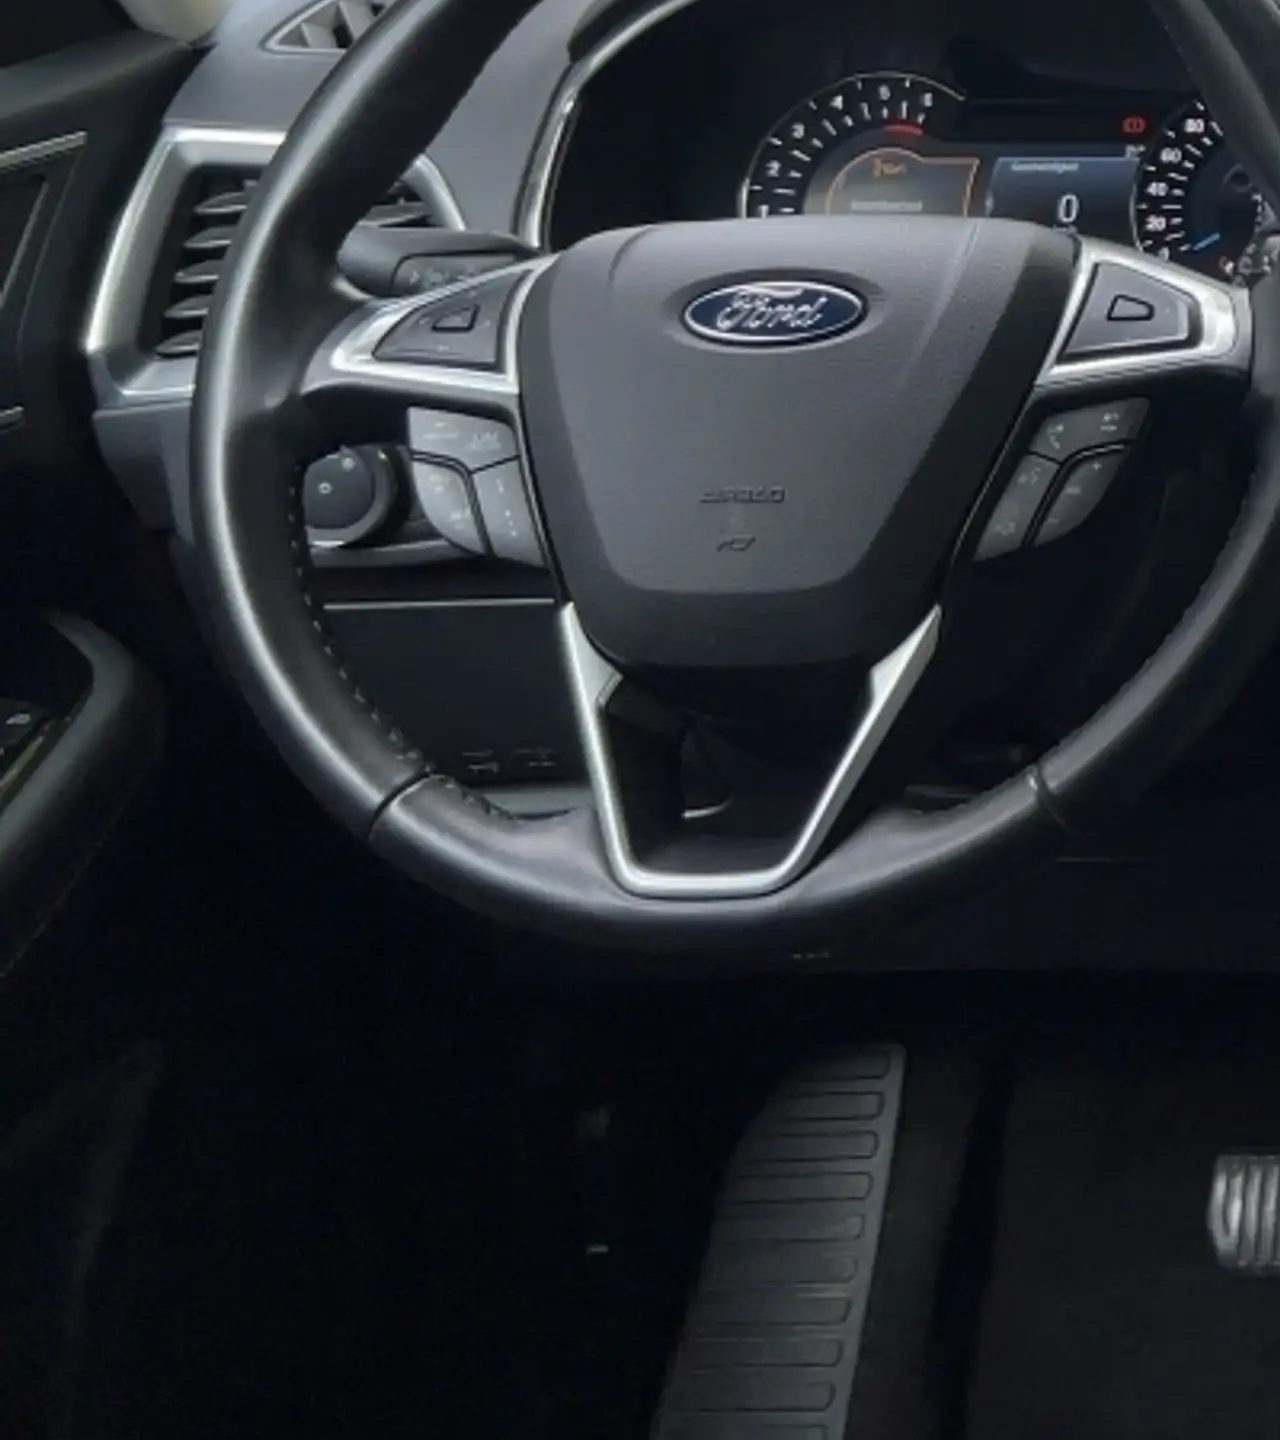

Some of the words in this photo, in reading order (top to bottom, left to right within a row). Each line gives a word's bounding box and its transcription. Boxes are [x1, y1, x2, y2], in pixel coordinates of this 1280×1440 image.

[830, 94, 843, 109] 4
[791, 123, 805, 139] 3
[1161, 148, 1182, 164] 60
[766, 161, 781, 177] 2
[1146, 182, 1168, 197] 40
[1058, 194, 1079, 223] 0
[716, 289, 829, 332] Ford
